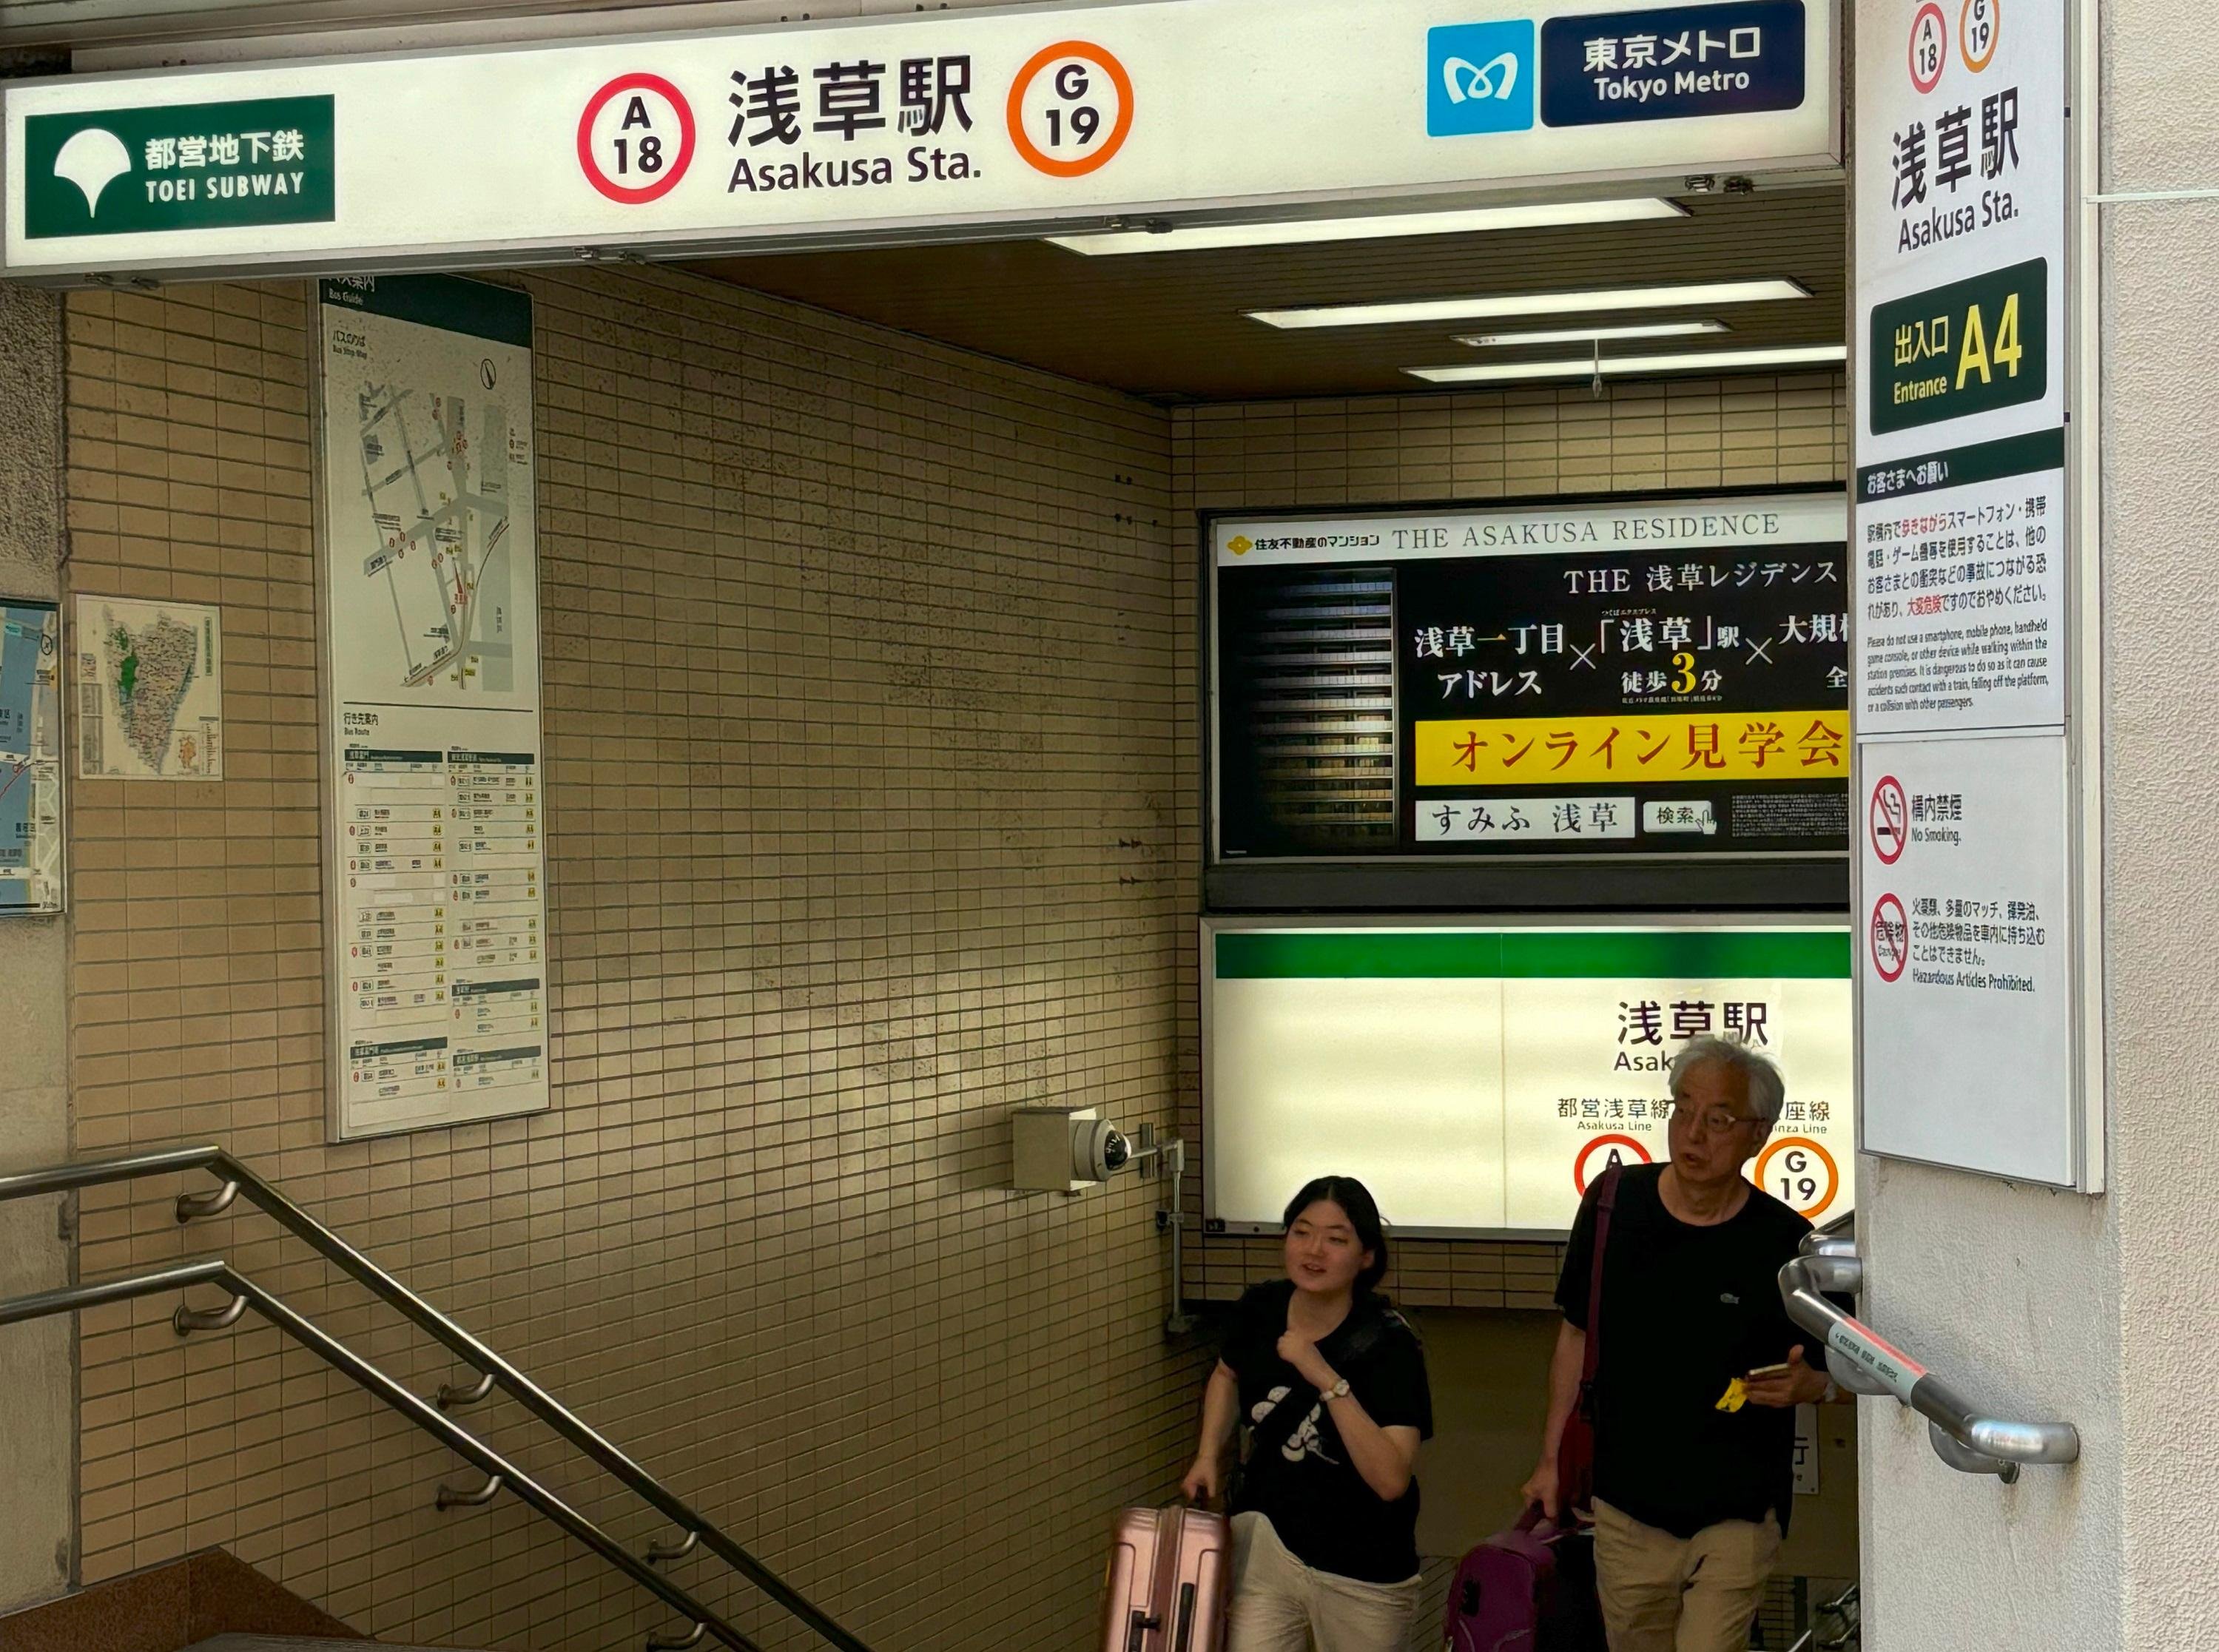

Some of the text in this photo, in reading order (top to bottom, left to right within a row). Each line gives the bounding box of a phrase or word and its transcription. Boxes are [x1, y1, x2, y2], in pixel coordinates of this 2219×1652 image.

[1974, 0, 1985, 21] G
[1923, 19, 1932, 41] A
[1972, 22, 1989, 53] 19
[1583, 27, 1760, 73] 東京メトロ
[1919, 44, 1936, 75] 18
[1054, 64, 1089, 101] G
[1593, 70, 1750, 103] Tokyo Metro
[622, 96, 653, 130] A
[727, 55, 973, 147] 浅草駅
[1045, 107, 1100, 146] 19
[144, 129, 305, 171] 都営地下鉄
[613, 136, 663, 175] 18
[1892, 87, 2020, 212] 浅草駅
[727, 146, 982, 194] Asakusa Sta.
[146, 172, 305, 203] TOEI SUBWAY
[1898, 190, 2019, 254] Asakusa Sta.
[329, 276, 375, 292] ス案内
[1893, 315, 1949, 367] 出入口
[1956, 294, 2022, 391] A4
[1893, 376, 1947, 405] Entrance
[1867, 461, 1948, 494] お客さまへお願い
[1255, 535, 1380, 550] 住友不動産のマンション
[1392, 513, 1779, 550] THE ASAKUSA RESIDENCE
[1563, 562, 1839, 594] THE 浅草レジデンス
[1414, 623, 1563, 658] 浅草一丁目
[1600, 616, 1740, 653] 「浅草」駅
[2035, 636, 2047, 650] the
[1621, 653, 1723, 694] 徒歩3分
[1977, 659, 1986, 672] do
[1988, 661, 1995, 671] so
[2007, 658, 2012, 669] it
[2013, 658, 2025, 669] can
[2027, 657, 2047, 668] cause
[1437, 670, 1542, 699] アドレス
[2004, 675, 2016, 687] the
[1451, 720, 1845, 772] オンライン見学会
[1432, 802, 1618, 833] すみふ 浅草
[1657, 806, 1694, 824] 検索
[1912, 793, 1962, 822] 構内禁煙
[1912, 826, 1962, 846] No Smoking.
[1913, 945, 1985, 965] ことはできません。
[1913, 968, 2036, 992] Hazardous Articles Prohibited.
[1617, 1001, 1768, 1045] 浅草駅
[1614, 1051, 1672, 1071] Asak
[1558, 1098, 1670, 1119] 都営浅草線
[1784, 1101, 1830, 1121] 座線
[1577, 1121, 1652, 1131] Asakusa Line
[1775, 1124, 1828, 1133] inza Line
[1785, 1150, 1807, 1173] G
[1780, 1178, 1816, 1201] 19
